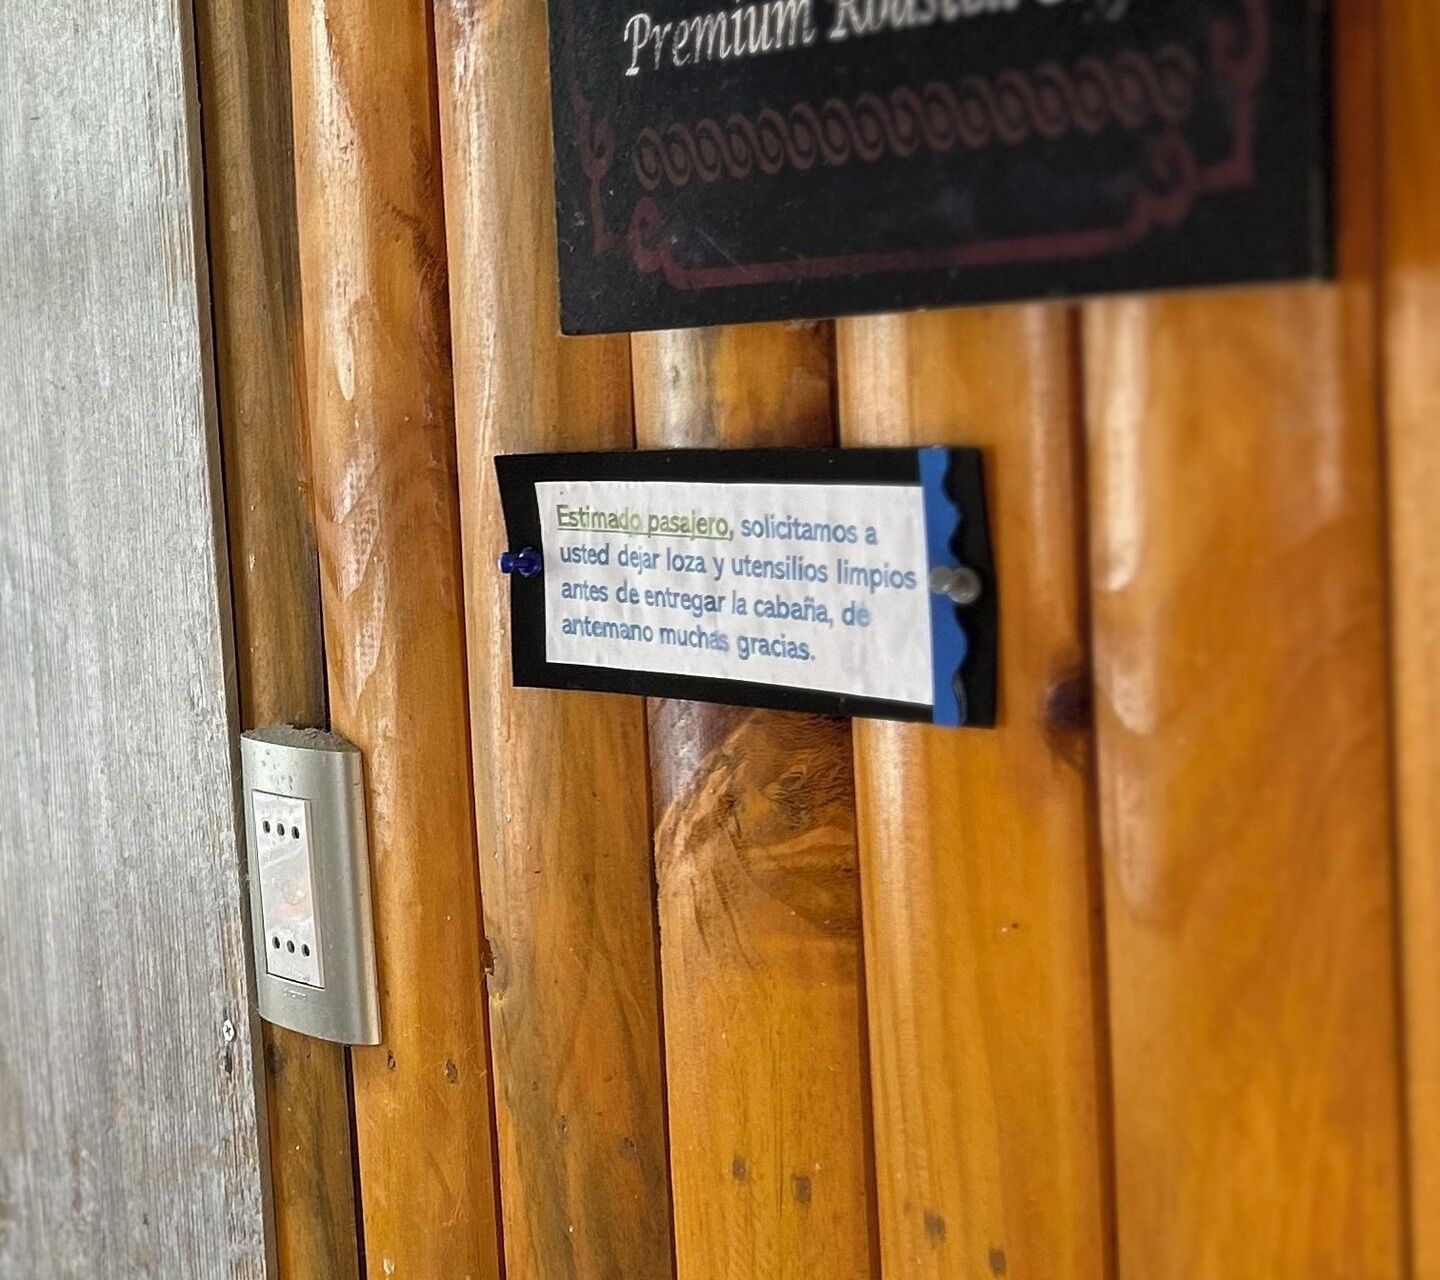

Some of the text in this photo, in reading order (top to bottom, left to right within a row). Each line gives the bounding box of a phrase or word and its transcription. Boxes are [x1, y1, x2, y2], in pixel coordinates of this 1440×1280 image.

[556, 504, 878, 546] Estimado pasajero, solicitamos a
[560, 542, 917, 594] usted dejar loza y utensilios limpios
[561, 578, 872, 629] antes de entregar la cabaña, de
[562, 616, 816, 661] antemano muchas gracias.
